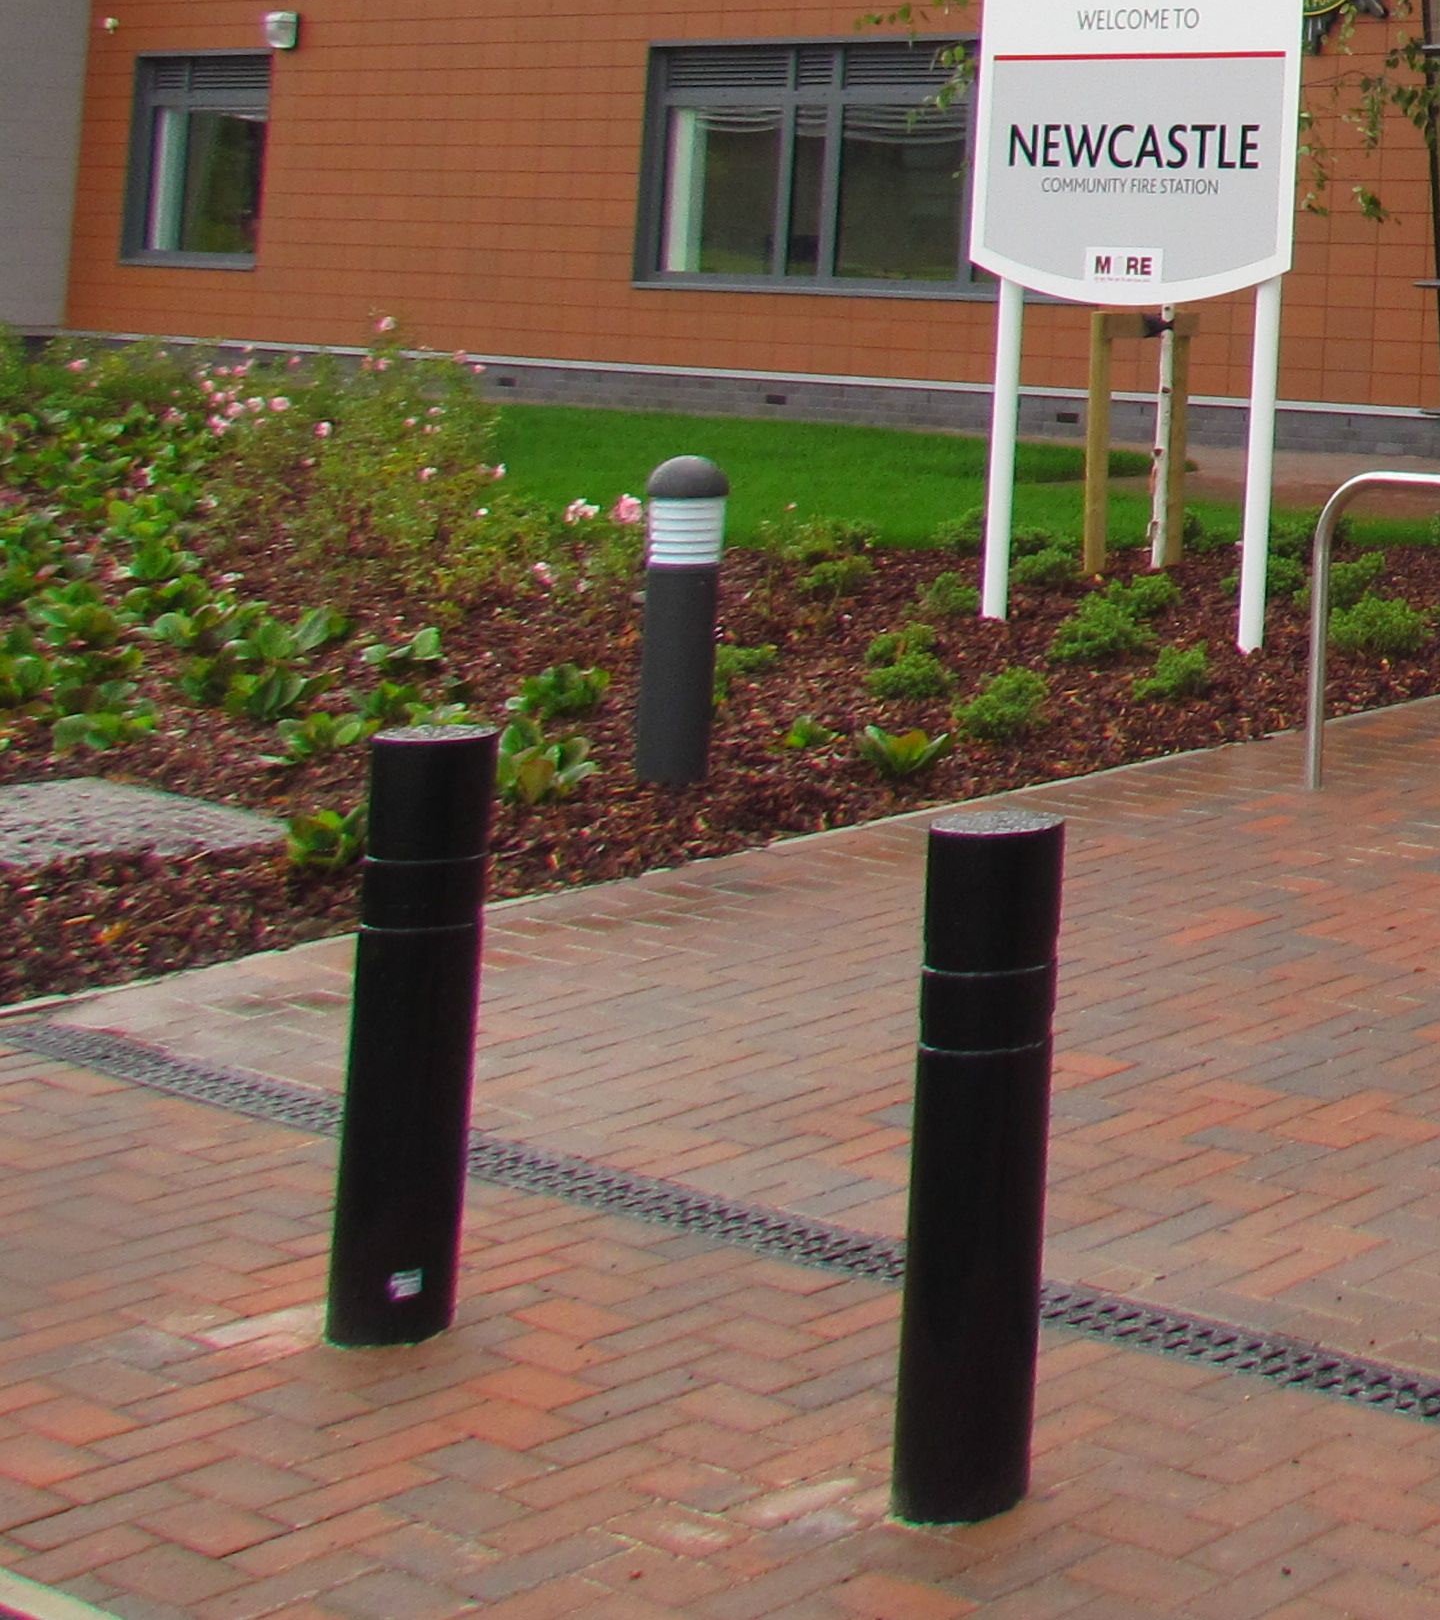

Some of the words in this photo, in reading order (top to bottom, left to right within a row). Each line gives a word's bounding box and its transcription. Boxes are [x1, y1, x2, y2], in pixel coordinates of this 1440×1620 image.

[1077, 8, 1170, 30] WELCOME
[1173, 7, 1200, 29] TO
[1008, 124, 1261, 169] NEWCASTLE
[1041, 177, 1128, 194] COMMUNITY
[1130, 178, 1156, 194] FIRE
[1160, 179, 1219, 195] STATION
